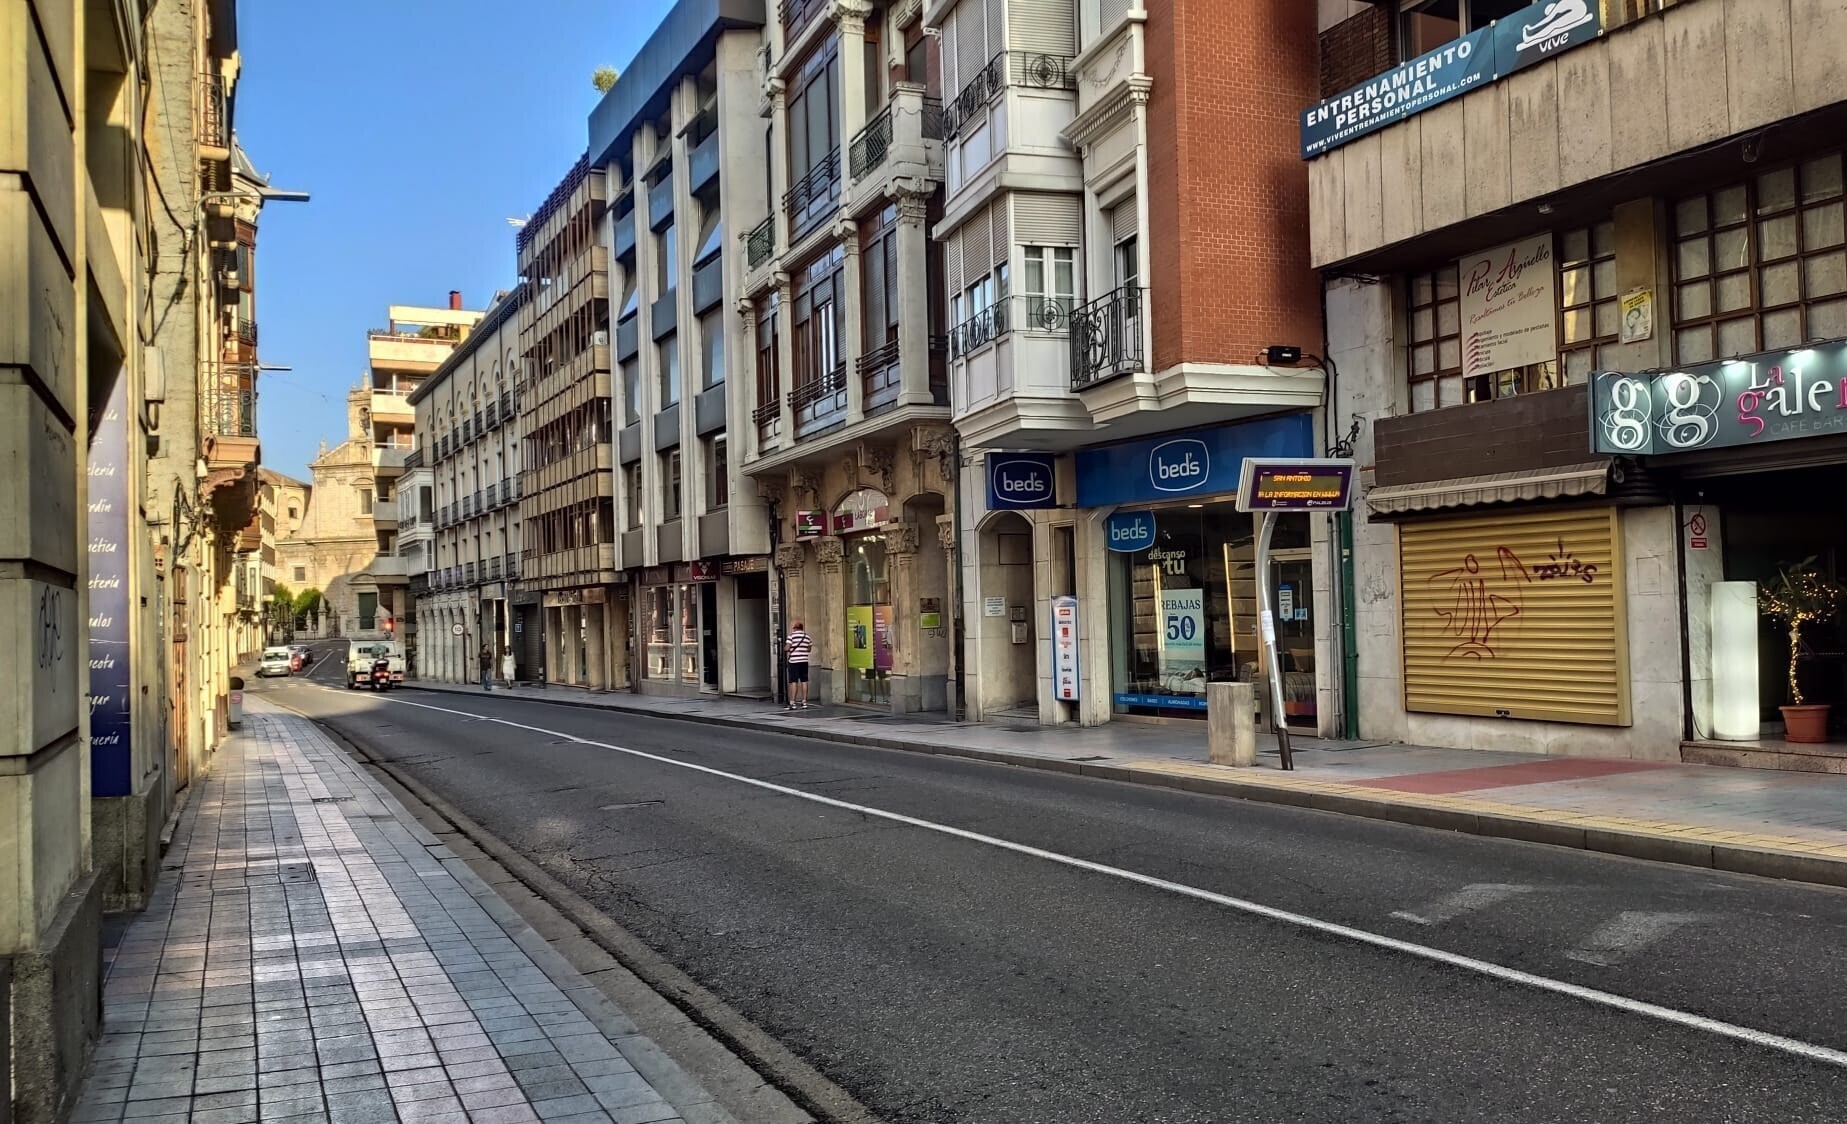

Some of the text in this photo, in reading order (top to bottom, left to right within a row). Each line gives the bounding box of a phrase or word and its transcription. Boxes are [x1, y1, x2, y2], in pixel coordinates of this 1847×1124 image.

[1306, 41, 1472, 127] ENTRENAMIENTO
[1306, 72, 1481, 153] WWW.VIVEENTRENAMIENTOPERSONAL.COM
[1336, 75, 1437, 129] PERSONAL
[1464, 260, 1493, 296] Pilar
[1748, 361, 1785, 389] La
[1159, 452, 1200, 479] bed's
[1273, 474, 1286, 482] SAN
[1286, 474, 1312, 482] ANTONIO
[1003, 471, 1044, 492] bed's
[1111, 518, 1148, 541] bed's
[734, 559, 755, 572] PASAJE
[1161, 599, 1201, 611] REBAJAS
[1167, 615, 1196, 641] 50
[90, 695, 110, 717] gar
